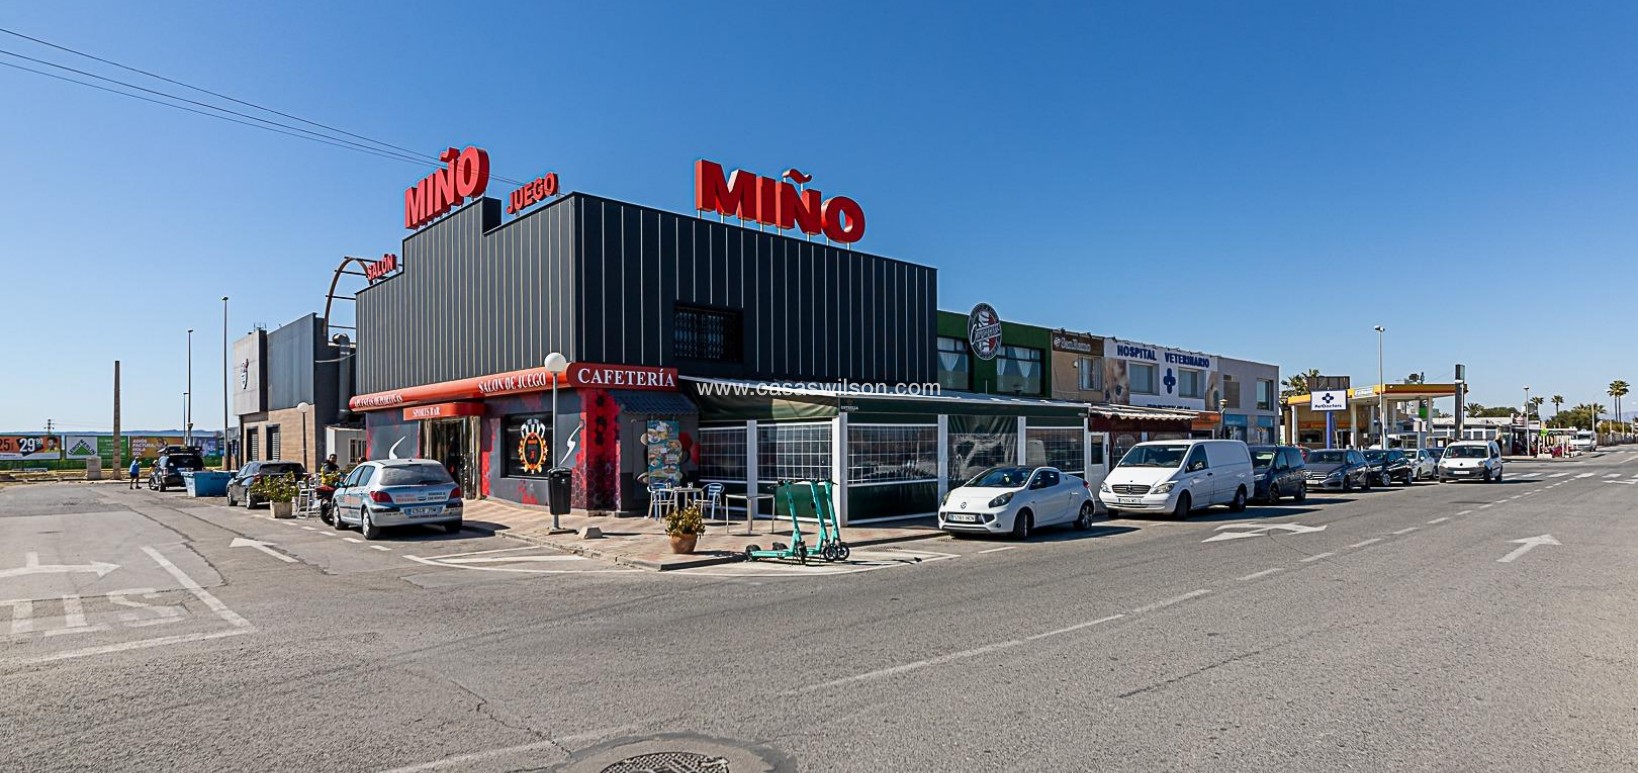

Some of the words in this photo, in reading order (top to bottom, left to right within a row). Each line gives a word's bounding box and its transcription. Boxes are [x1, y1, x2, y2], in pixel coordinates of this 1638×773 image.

[405, 146, 489, 230] MIÑO
[506, 172, 559, 214] JUEGO
[696, 159, 866, 245] MIÑO
[367, 253, 397, 281] SALÓN
[1117, 345, 1157, 361] HOSPITAL
[1164, 352, 1210, 369] VETERINARIO
[505, 377, 516, 391] DE
[517, 372, 547, 389] JUEGO
[577, 368, 676, 388] CAFETERÍA
[412, 408, 430, 417] SPORTS
[430, 406, 441, 416] BAR
[19, 437, 36, 453] 29
